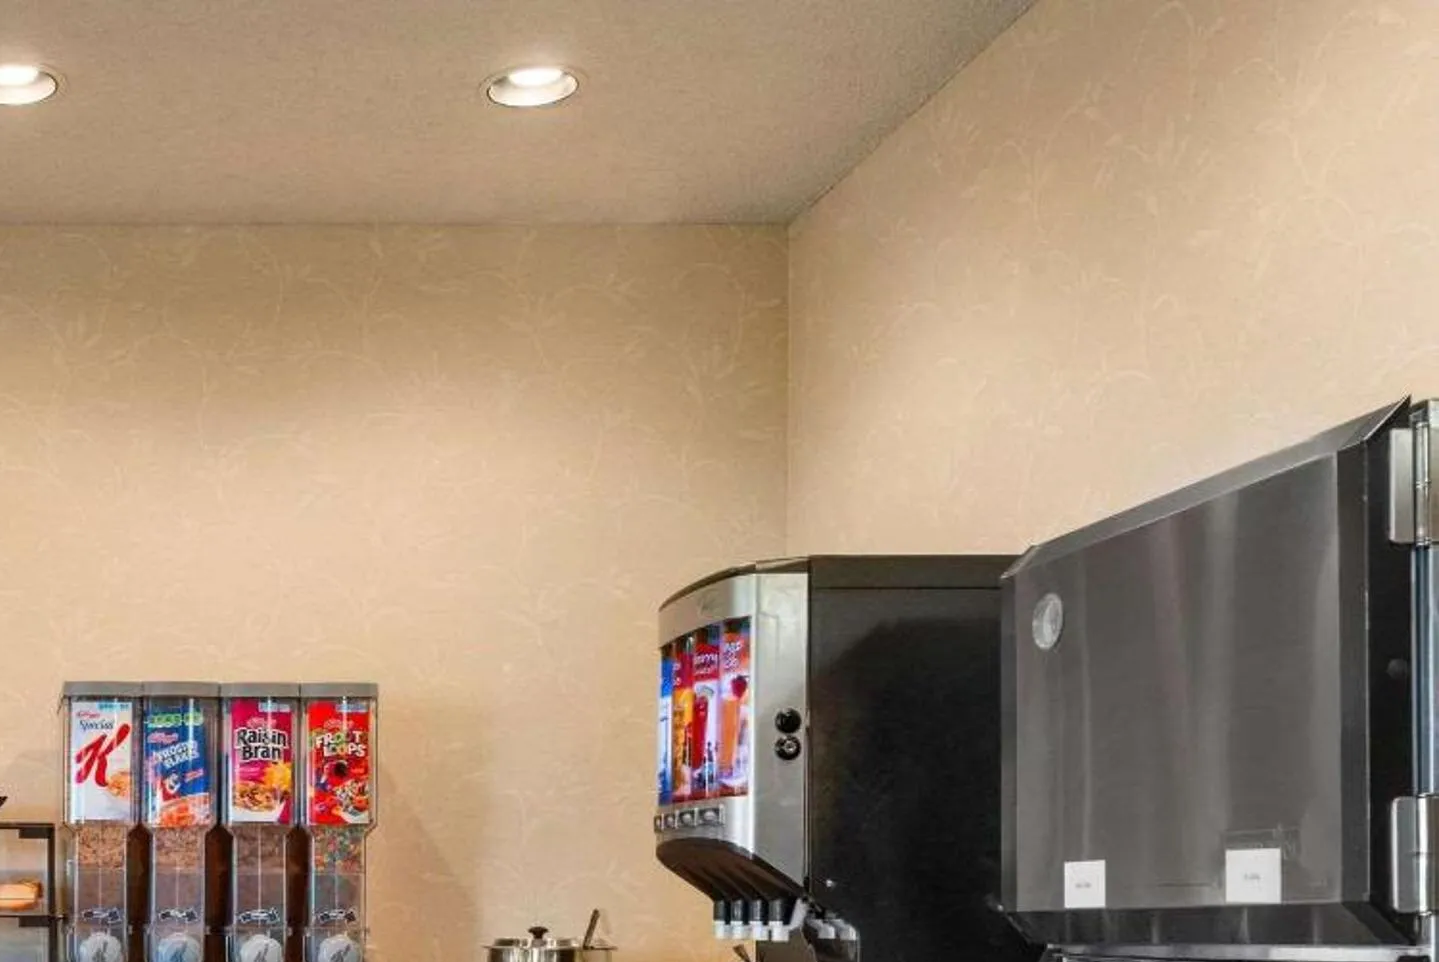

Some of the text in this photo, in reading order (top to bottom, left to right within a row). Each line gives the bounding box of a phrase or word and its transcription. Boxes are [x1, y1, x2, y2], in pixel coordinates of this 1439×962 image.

[236, 728, 287, 747] Raisin
[75, 723, 131, 788] K
[241, 745, 282, 761] Bran
